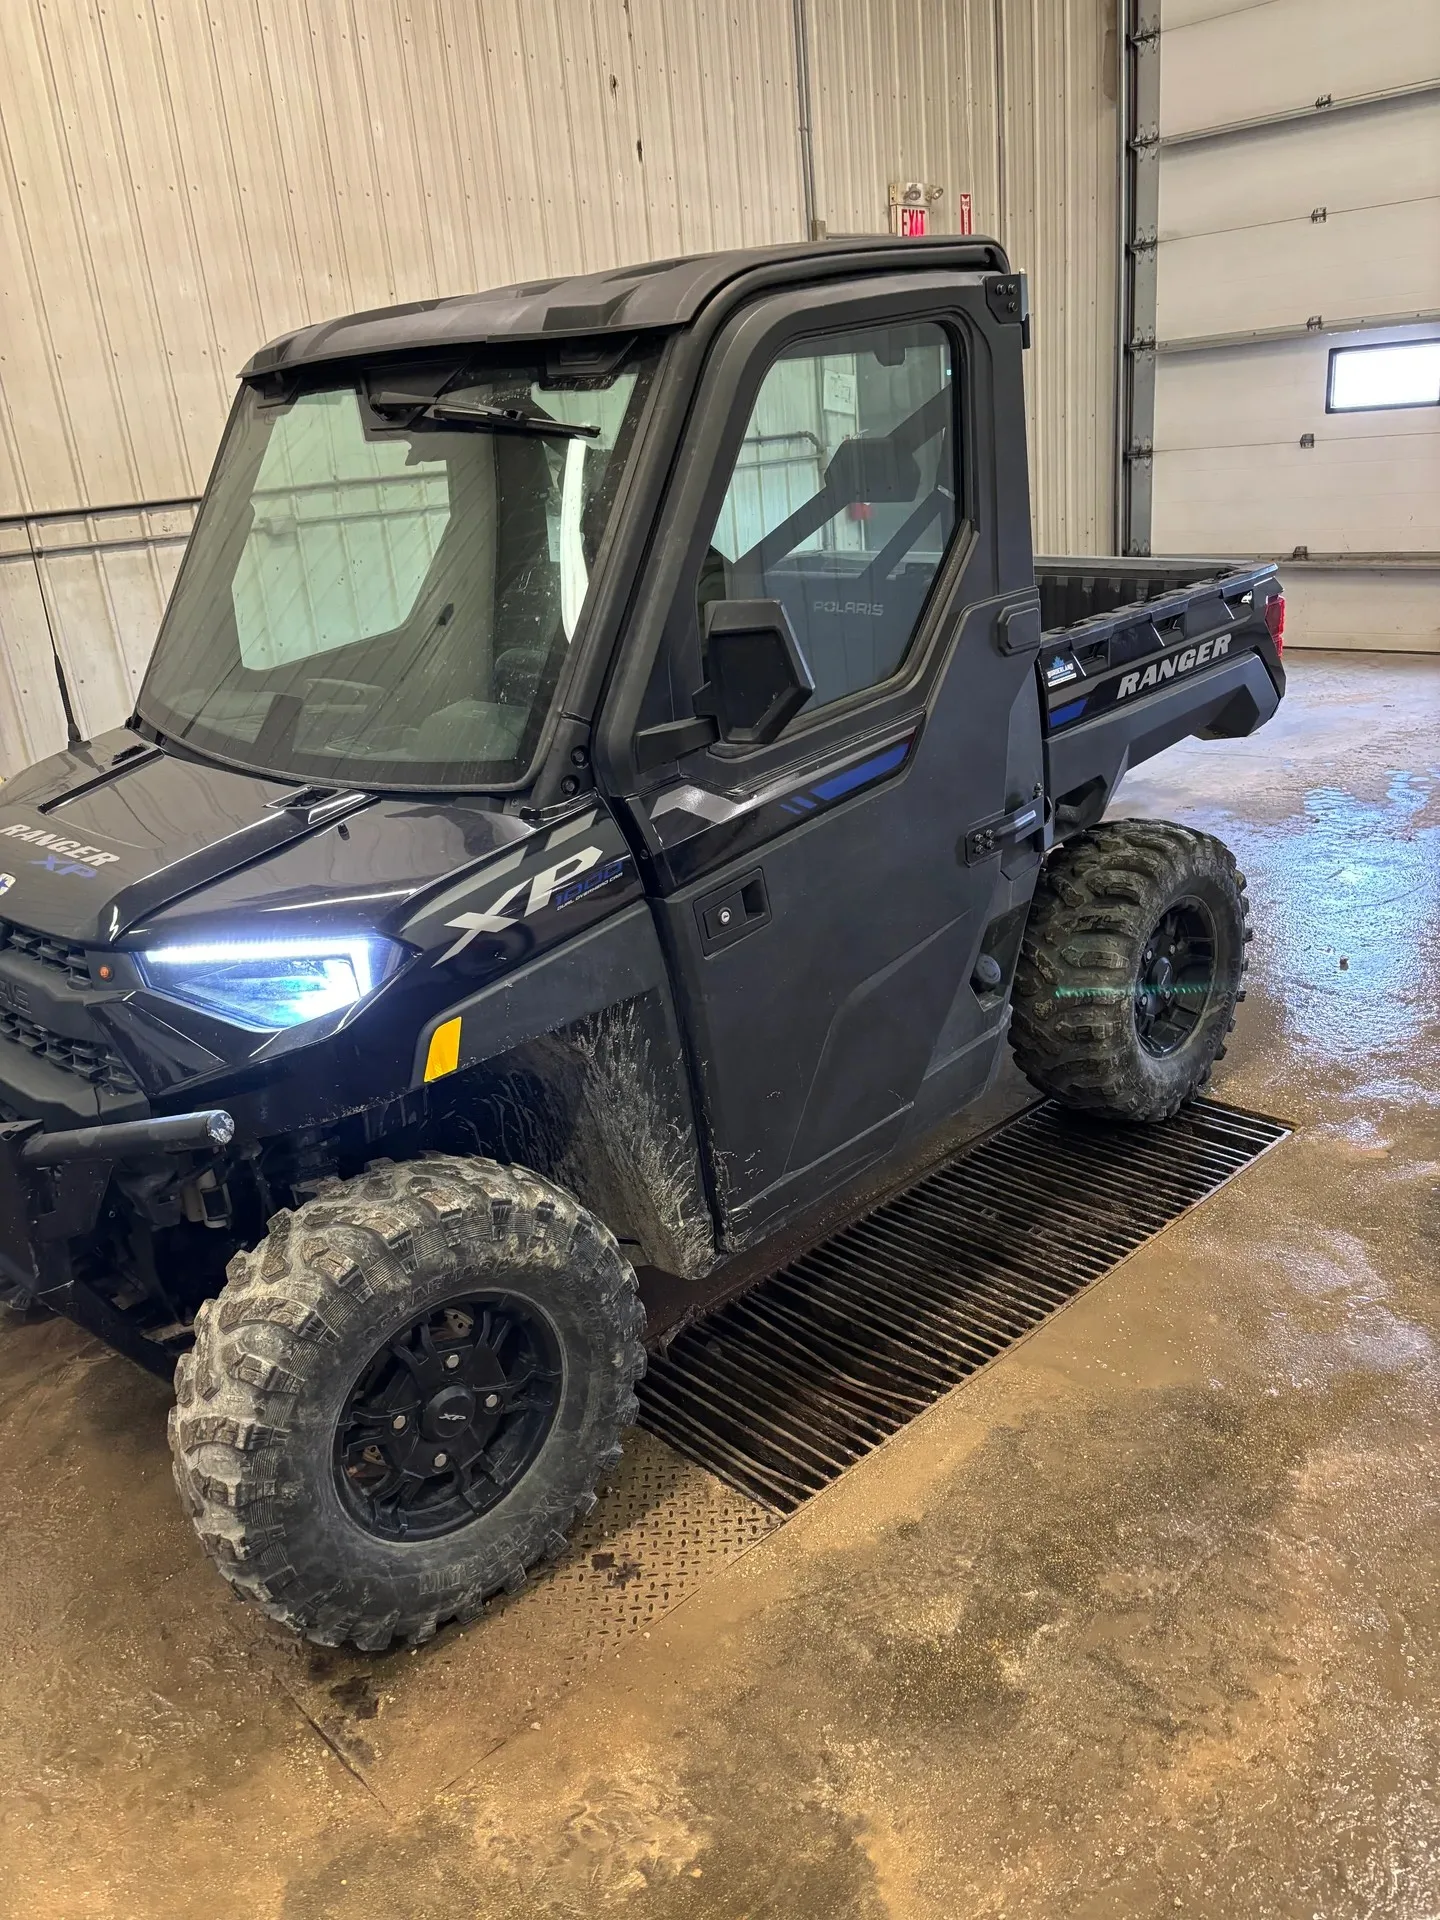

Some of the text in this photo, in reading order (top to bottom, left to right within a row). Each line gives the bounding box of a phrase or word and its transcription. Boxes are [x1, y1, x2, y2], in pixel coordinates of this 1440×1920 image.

[901, 209, 925, 236] EXIT
[813, 601, 884, 616] POLARIS
[1116, 633, 1232, 700] RANGER
[0, 824, 120, 867] RANGER
[28, 855, 98, 879] XP
[431, 846, 603, 968] XP
